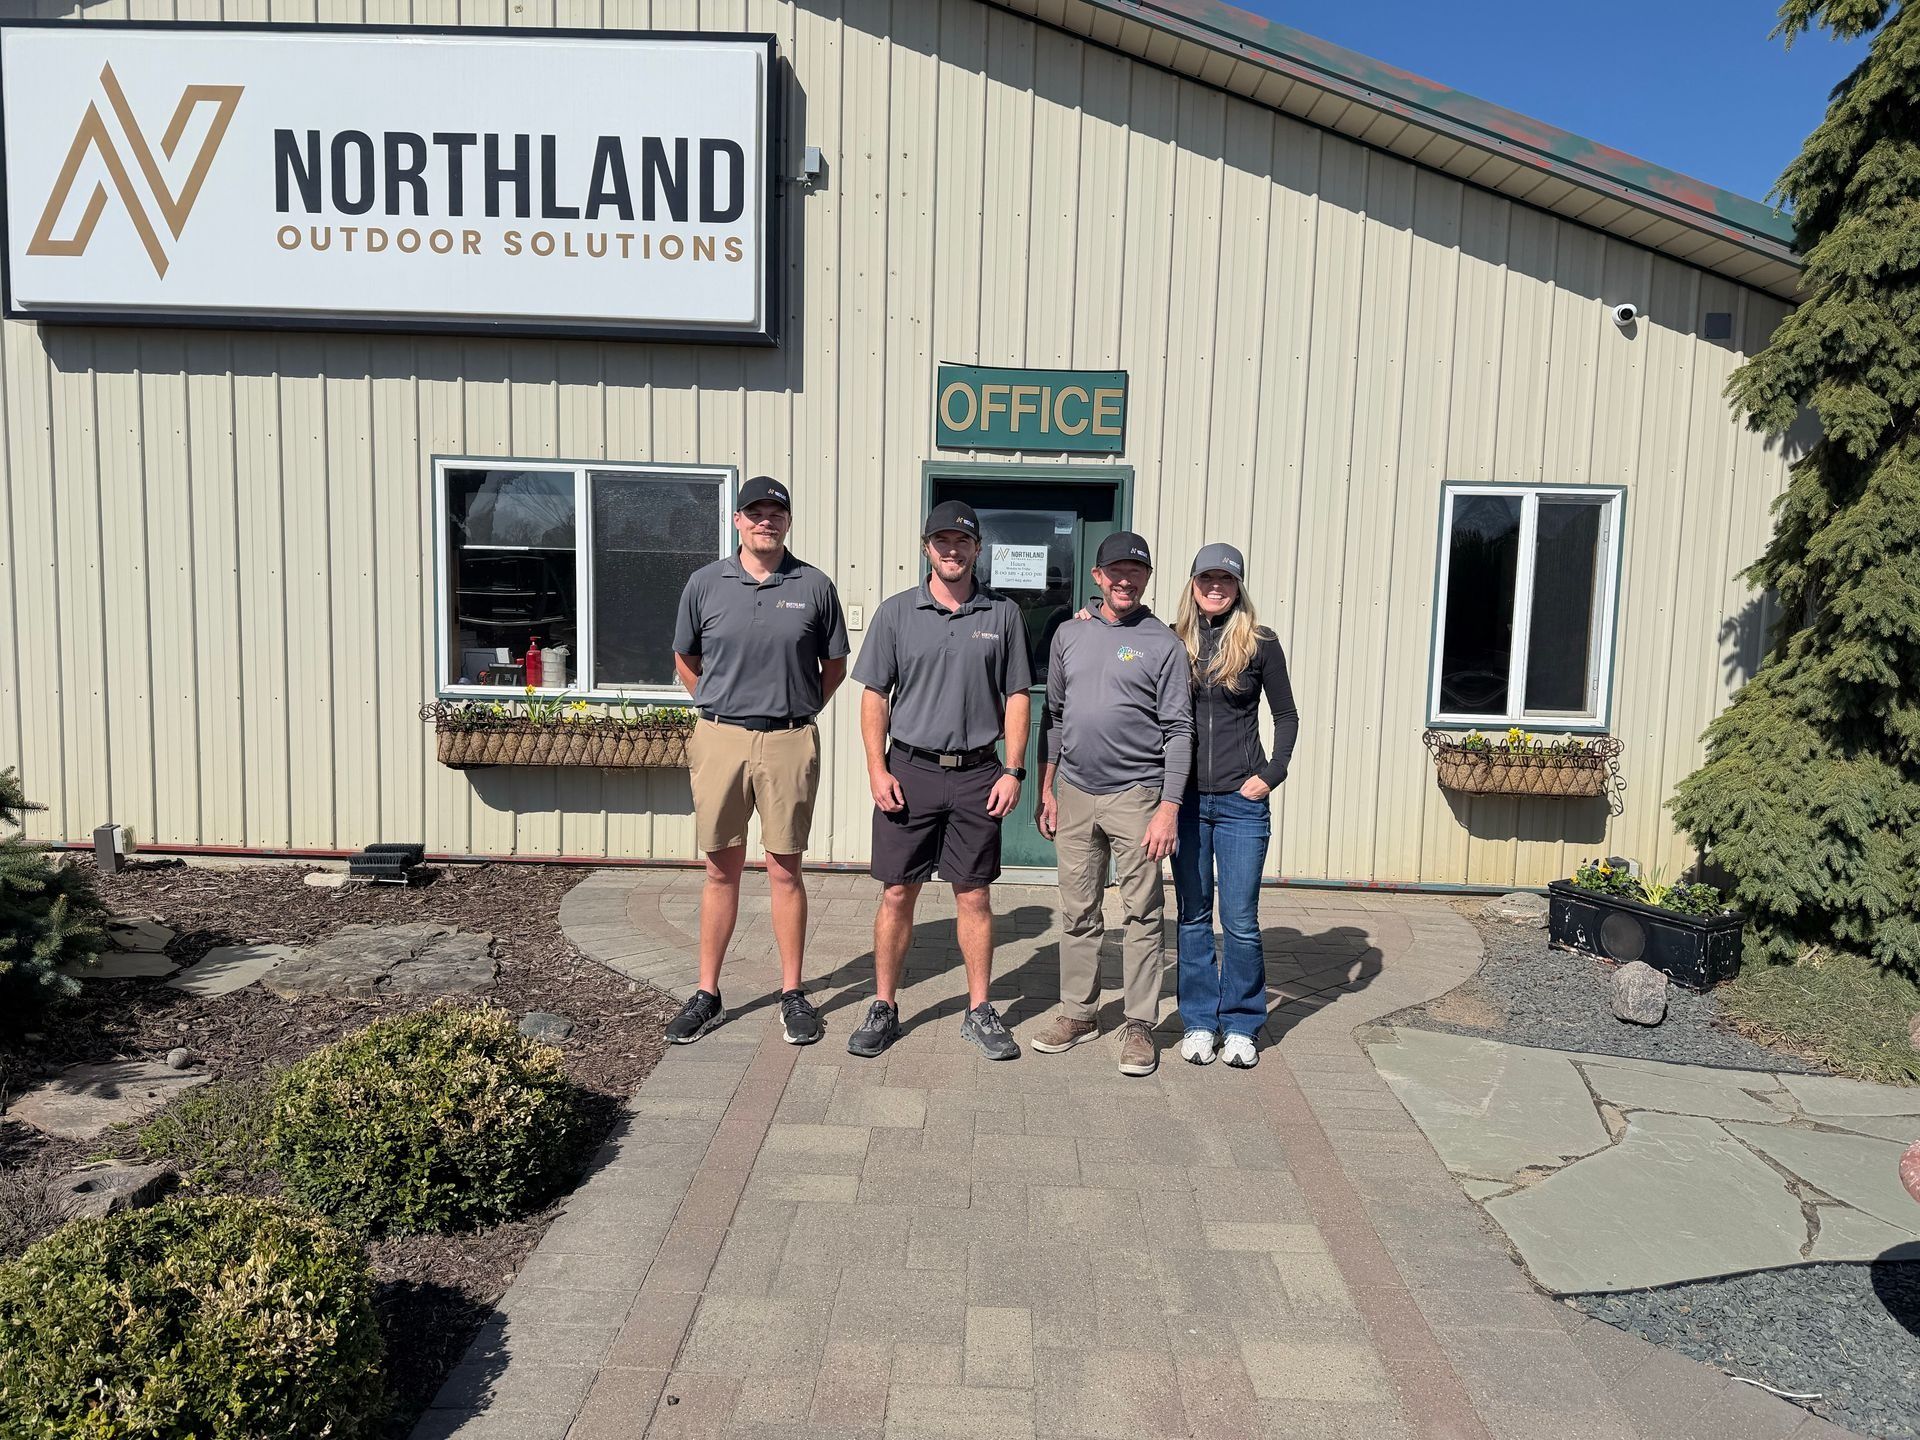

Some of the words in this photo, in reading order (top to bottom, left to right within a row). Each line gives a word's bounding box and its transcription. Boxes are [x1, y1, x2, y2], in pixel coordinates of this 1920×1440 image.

[274, 128, 745, 224] NORTHLAND
[276, 224, 482, 255] OUTDOOR
[504, 230, 745, 262] SOLUTIONS
[940, 381, 1124, 436] OFFICE
